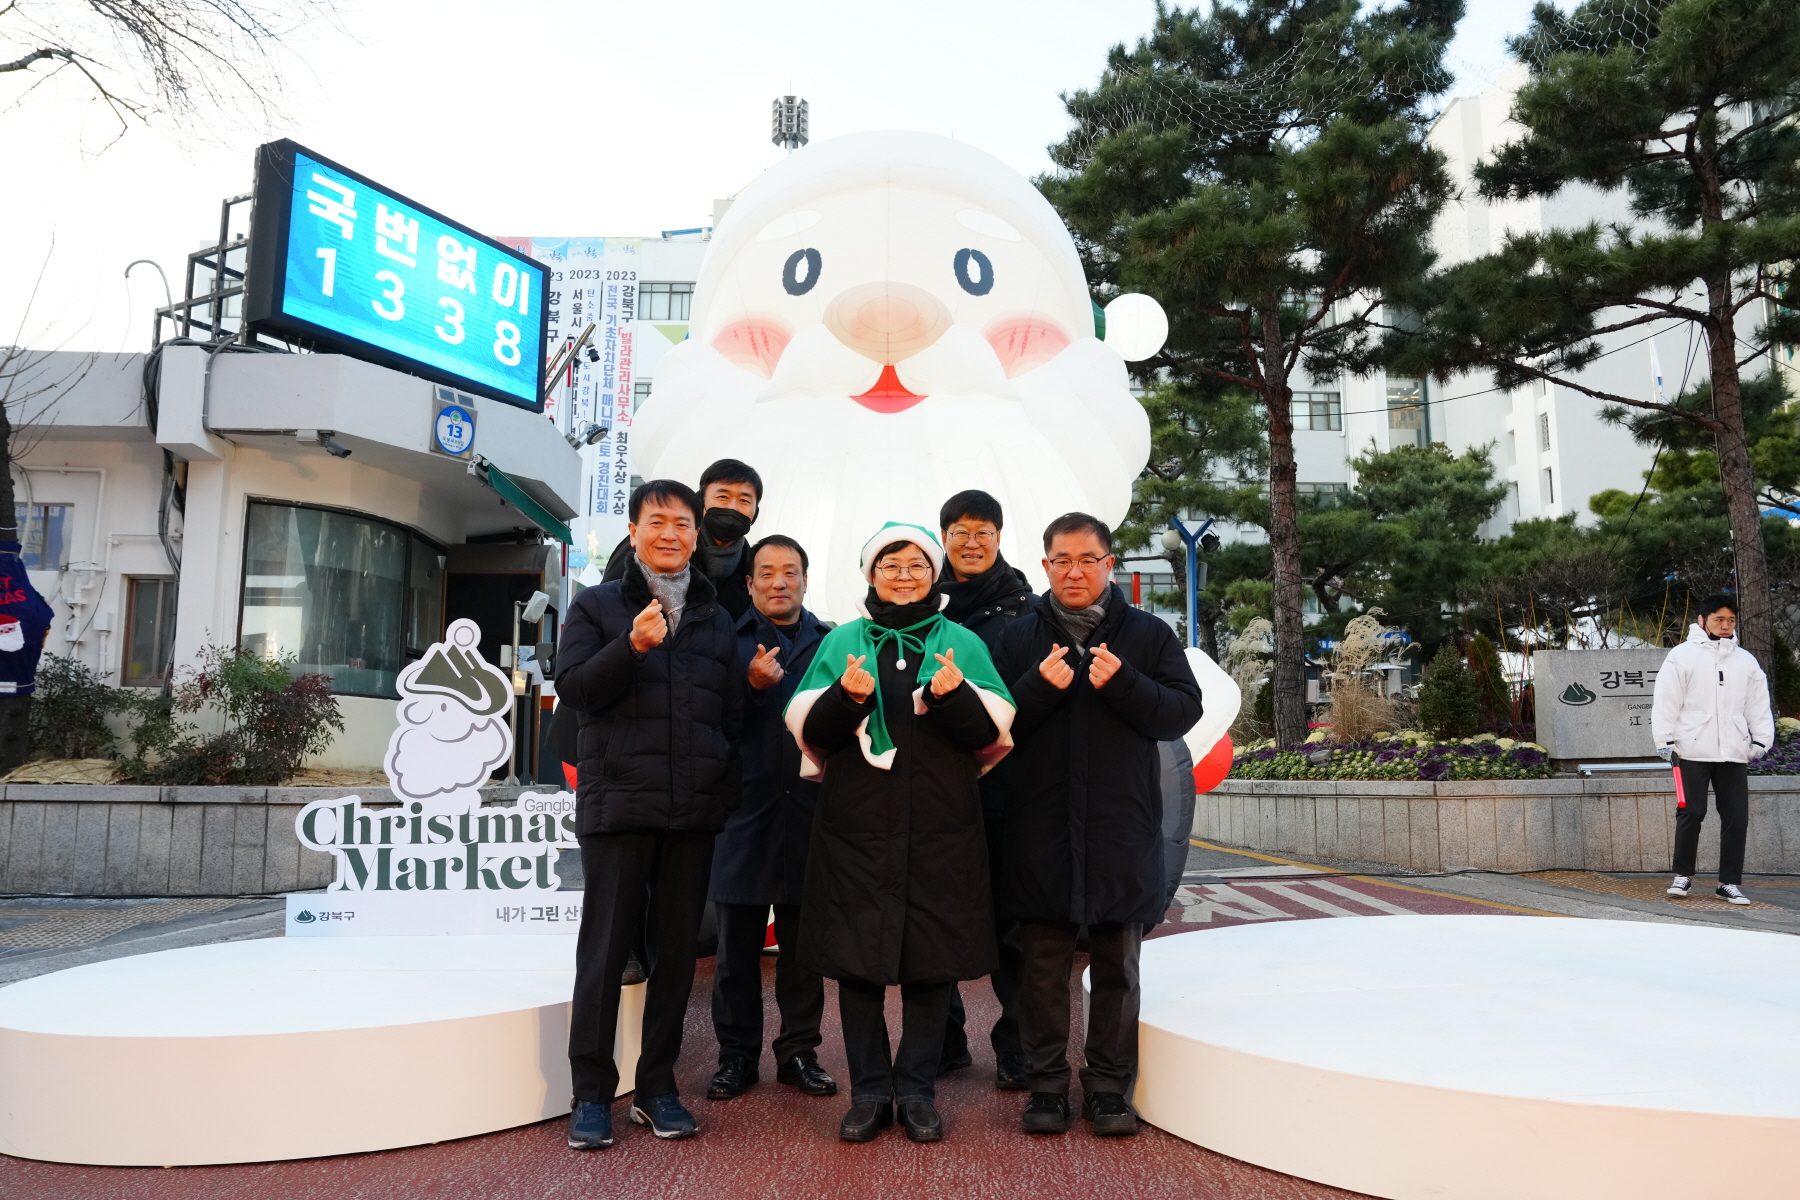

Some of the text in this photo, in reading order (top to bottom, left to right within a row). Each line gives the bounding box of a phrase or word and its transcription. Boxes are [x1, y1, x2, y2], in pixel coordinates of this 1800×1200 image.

[306, 172, 530, 316] 국번없이
[550, 271, 563, 282] 23
[569, 269, 600, 280] 2023
[606, 270, 637, 281] 2023
[316, 247, 522, 367] 1338
[547, 291, 562, 343] 강북구
[571, 288, 583, 328] 서울시
[586, 289, 595, 322] 탄소중
[621, 285, 636, 324] 강북구
[595, 284, 618, 514] 전국 기초자치단체 매니페스토 경진대회
[447, 424, 463, 438] 13
[613, 431, 629, 484] 최우수상
[612, 489, 626, 516] 수상
[0, 576, 13, 589] T
[0, 589, 27, 606] AS
[524, 798, 577, 815] Gangbu
[302, 801, 578, 846] Christmas
[335, 842, 556, 892] Market
[318, 911, 355, 922] 강북구
[496, 906, 526, 923] 내가
[530, 905, 560, 922] 그린
